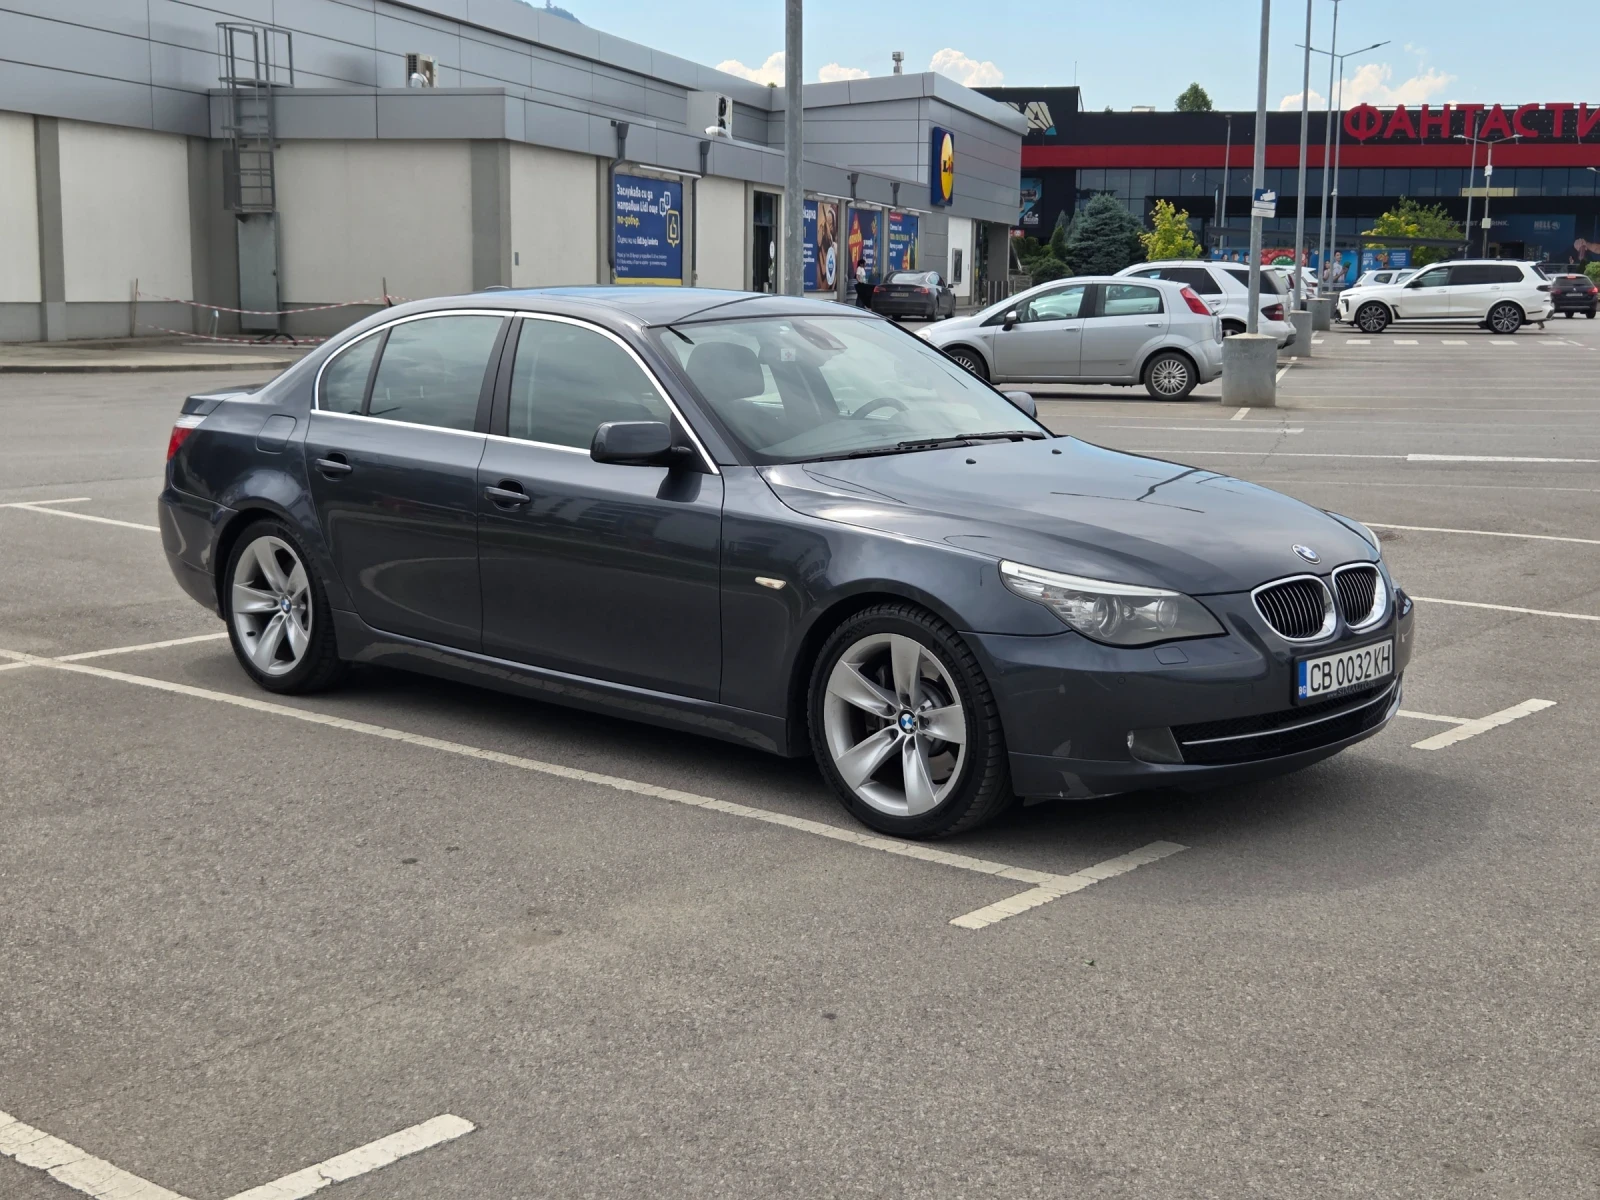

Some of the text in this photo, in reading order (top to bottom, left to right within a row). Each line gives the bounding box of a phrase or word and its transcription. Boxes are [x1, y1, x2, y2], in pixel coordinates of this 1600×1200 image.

[1310, 643, 1391, 692] CB 0032 KH
[1298, 685, 1307, 695] BG
